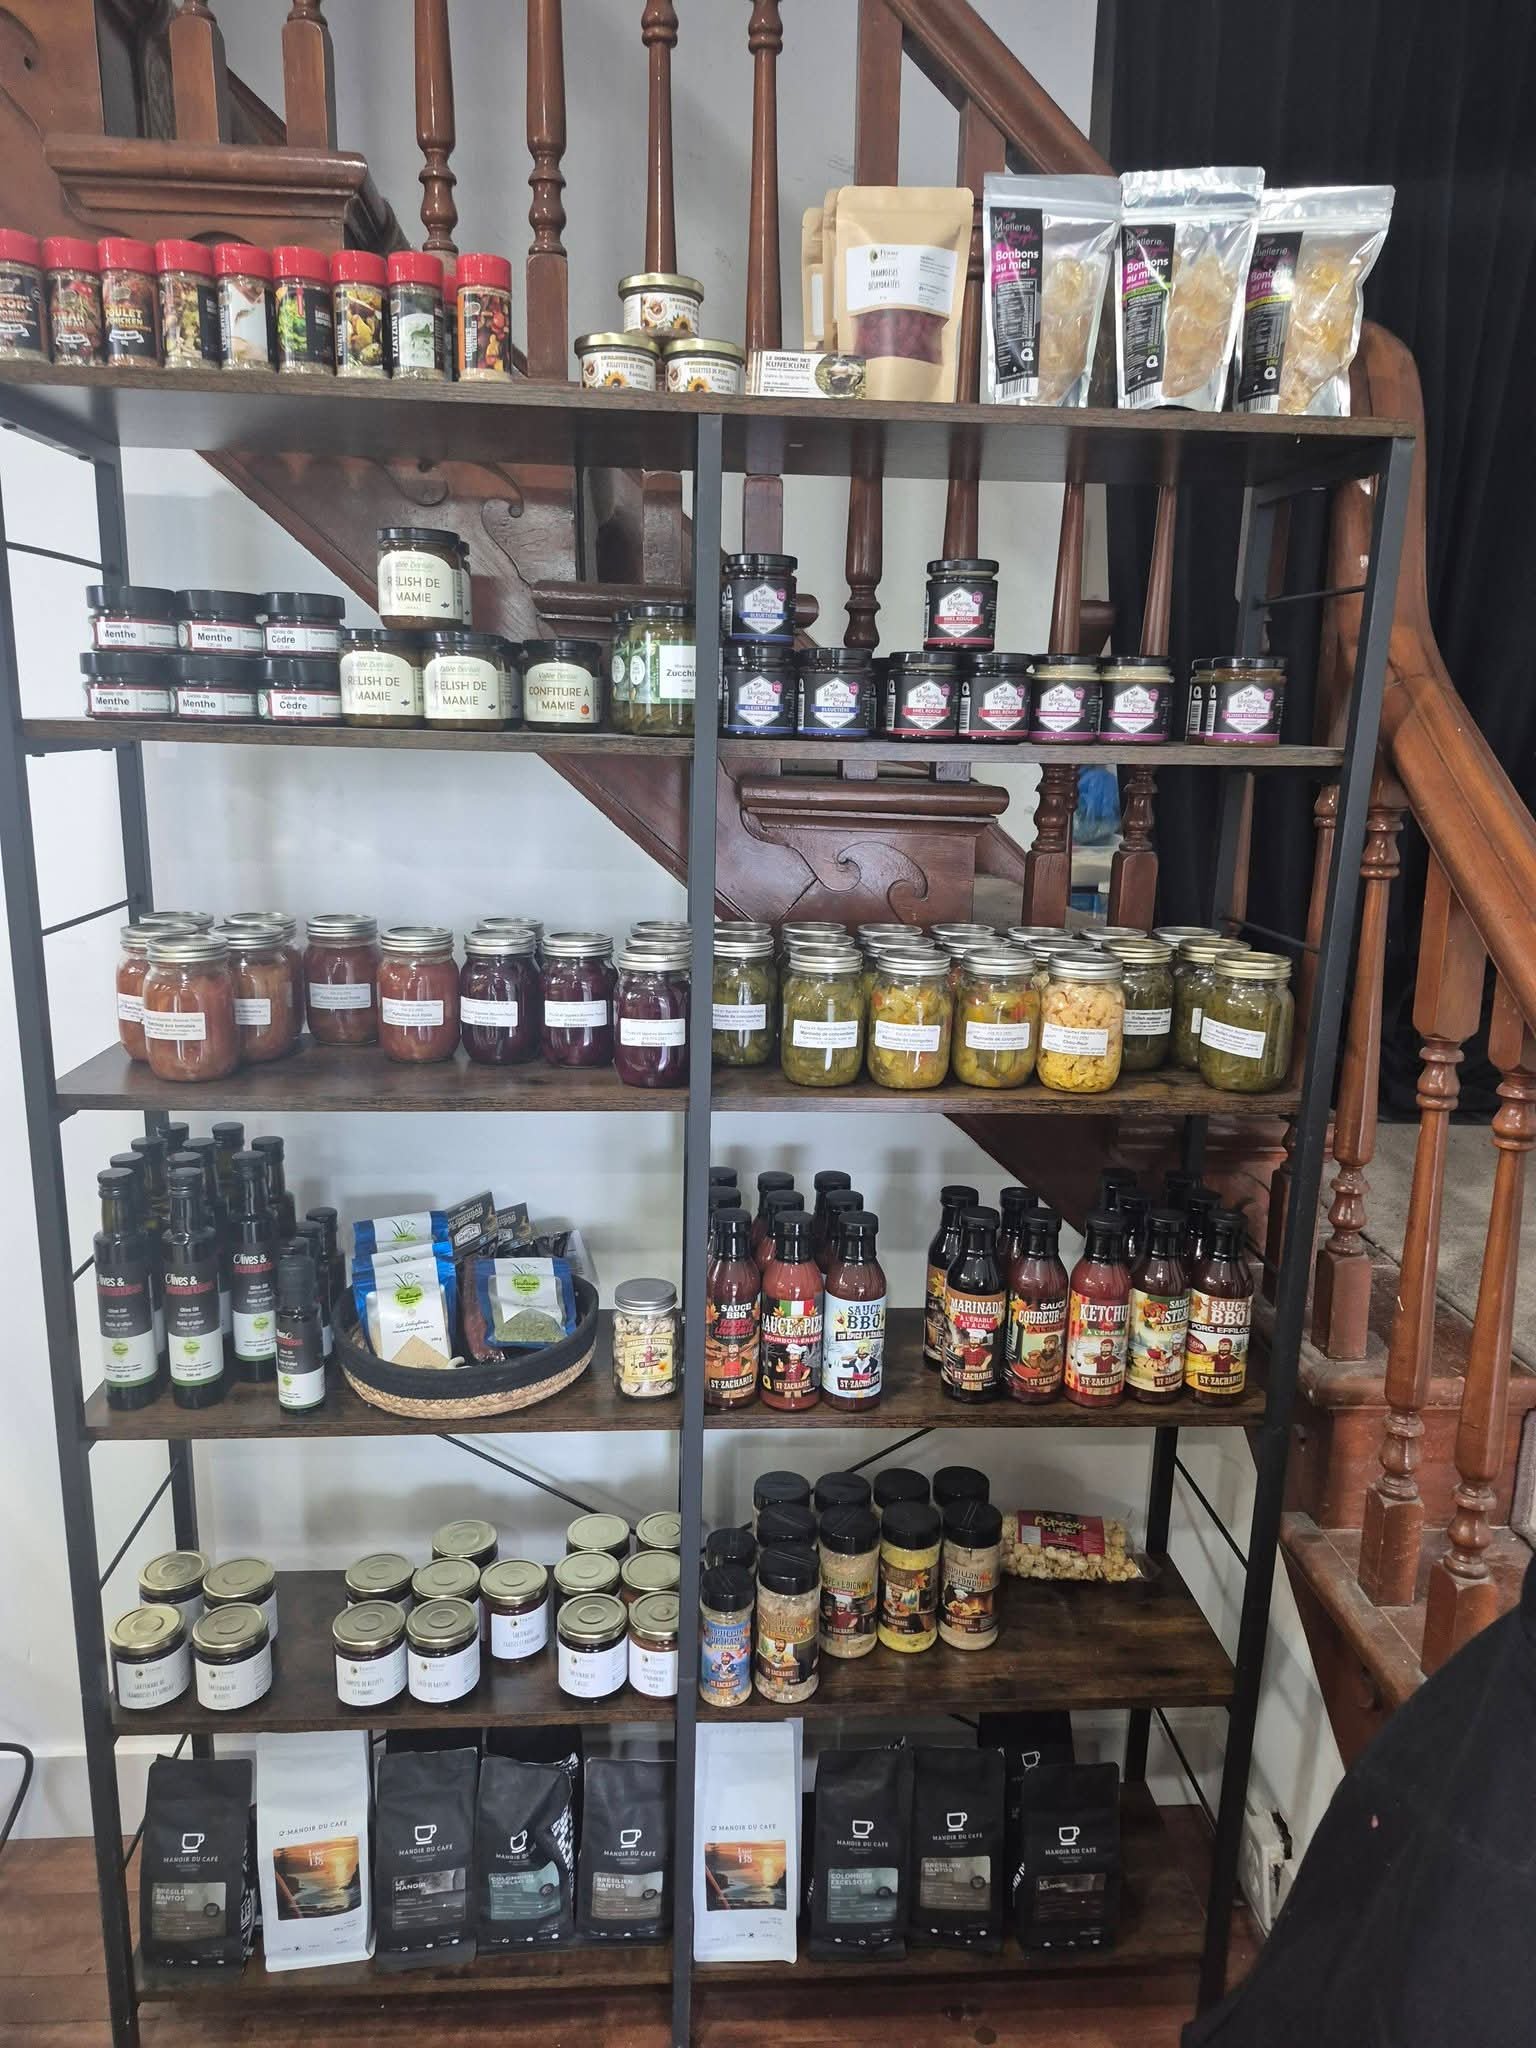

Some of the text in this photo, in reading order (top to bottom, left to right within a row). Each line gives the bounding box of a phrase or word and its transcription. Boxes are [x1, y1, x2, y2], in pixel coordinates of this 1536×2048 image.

[995, 248, 1039, 261] Bonbons
[996, 259, 1031, 273] au miel
[1127, 258, 1169, 273] Bonbons
[1126, 274, 1137, 284] au
[391, 315, 399, 357] TZATZIKI
[425, 577, 441, 588] DE
[197, 632, 233, 642] Menthe
[385, 677, 400, 687] DE
[473, 681, 487, 691] DE
[356, 690, 392, 701] MAMIE
[528, 686, 590, 697] CONFITURE À
[96, 697, 130, 705] Menthe
[182, 699, 217, 709] Menthe
[280, 700, 309, 710] Cèdre
[442, 695, 479, 706] MAMIE
[541, 701, 576, 711] MAMIE
[232, 1253, 267, 1265] Olives &
[117, 1276, 125, 1287] &
[165, 1273, 197, 1286] Olives &
[721, 1302, 752, 1312] SAUCE
[847, 1304, 881, 1315] SAUCE
[1211, 1300, 1247, 1312] SAUCE
[726, 1311, 747, 1319] BBQ
[959, 1315, 965, 1323] À
[1018, 1310, 1060, 1324] COUREUR
[1191, 1322, 1216, 1333] PORC
[711, 1374, 753, 1389] ST-ZACHARIE
[1034, 1516, 1088, 1530] Popcorn
[287, 1826, 316, 1836] MANOIR
[399, 1848, 424, 1856] MANOIR
[395, 1882, 426, 1892] MANOIR
[155, 1894, 185, 1902] SANTOS
